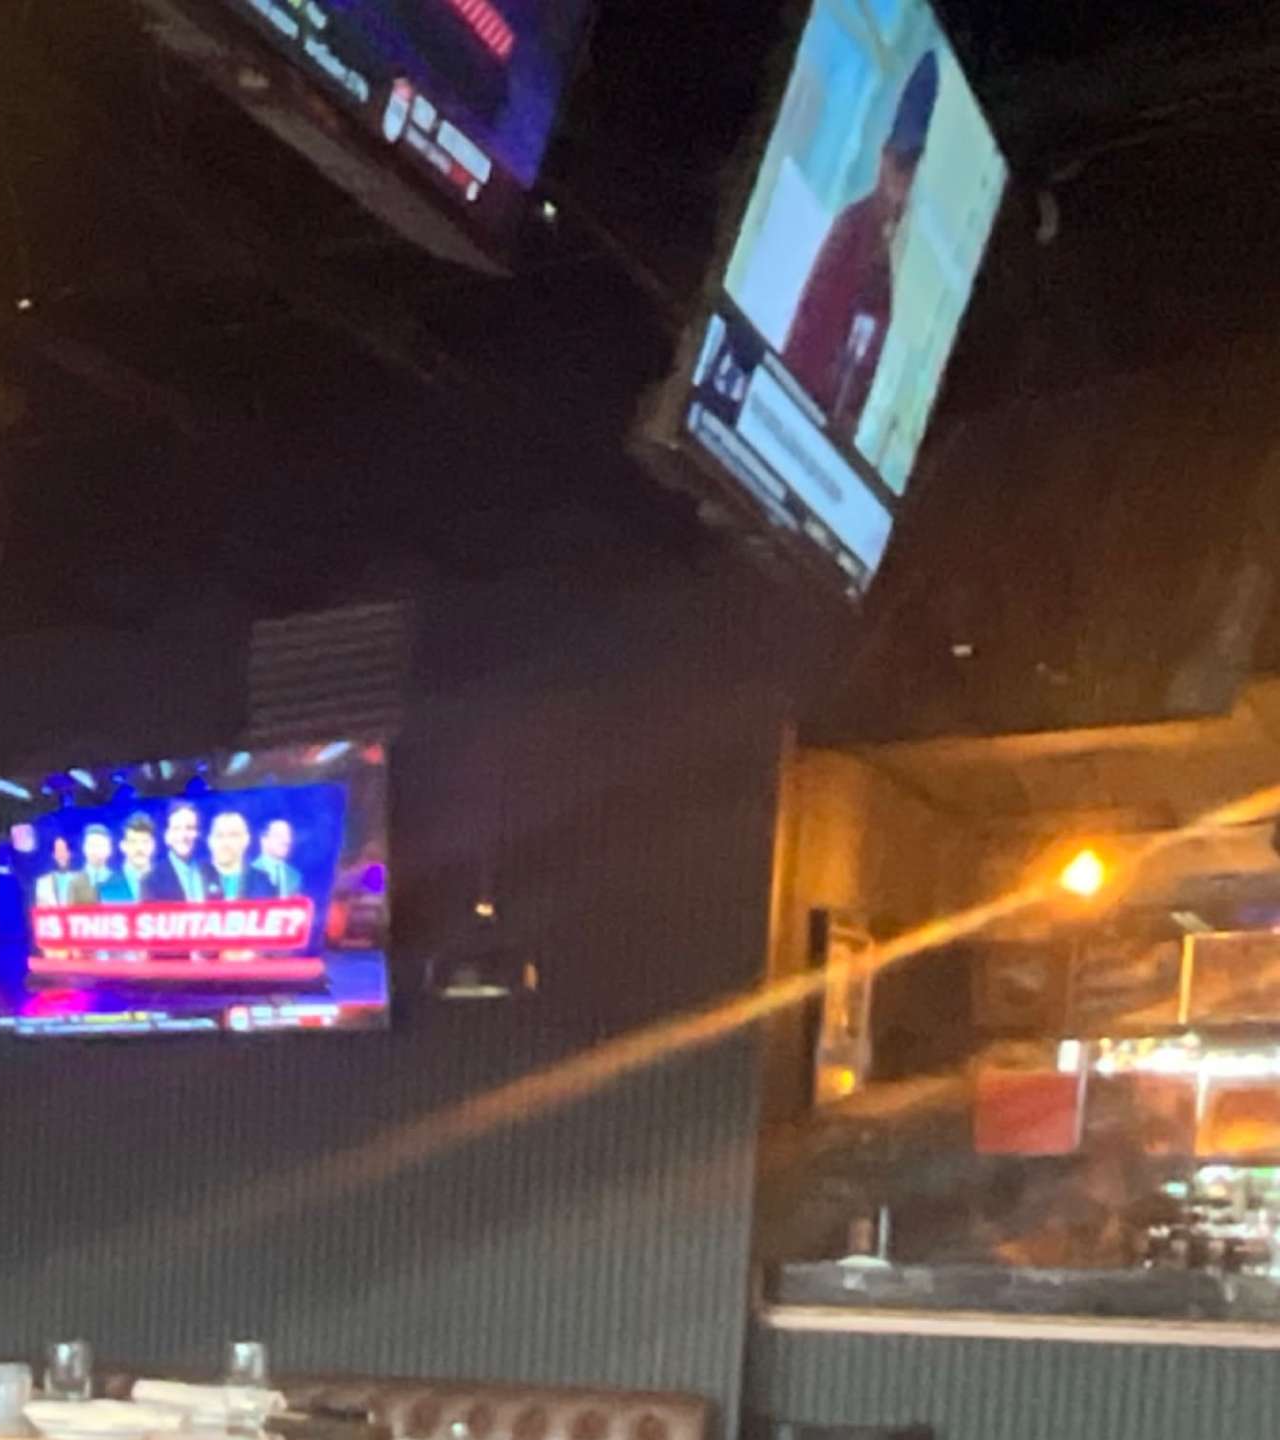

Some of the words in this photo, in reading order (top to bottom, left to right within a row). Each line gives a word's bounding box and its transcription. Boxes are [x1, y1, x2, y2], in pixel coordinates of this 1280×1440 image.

[38, 914, 63, 940] IS
[67, 913, 129, 940] THIS
[135, 907, 308, 940] SUITABLE?
